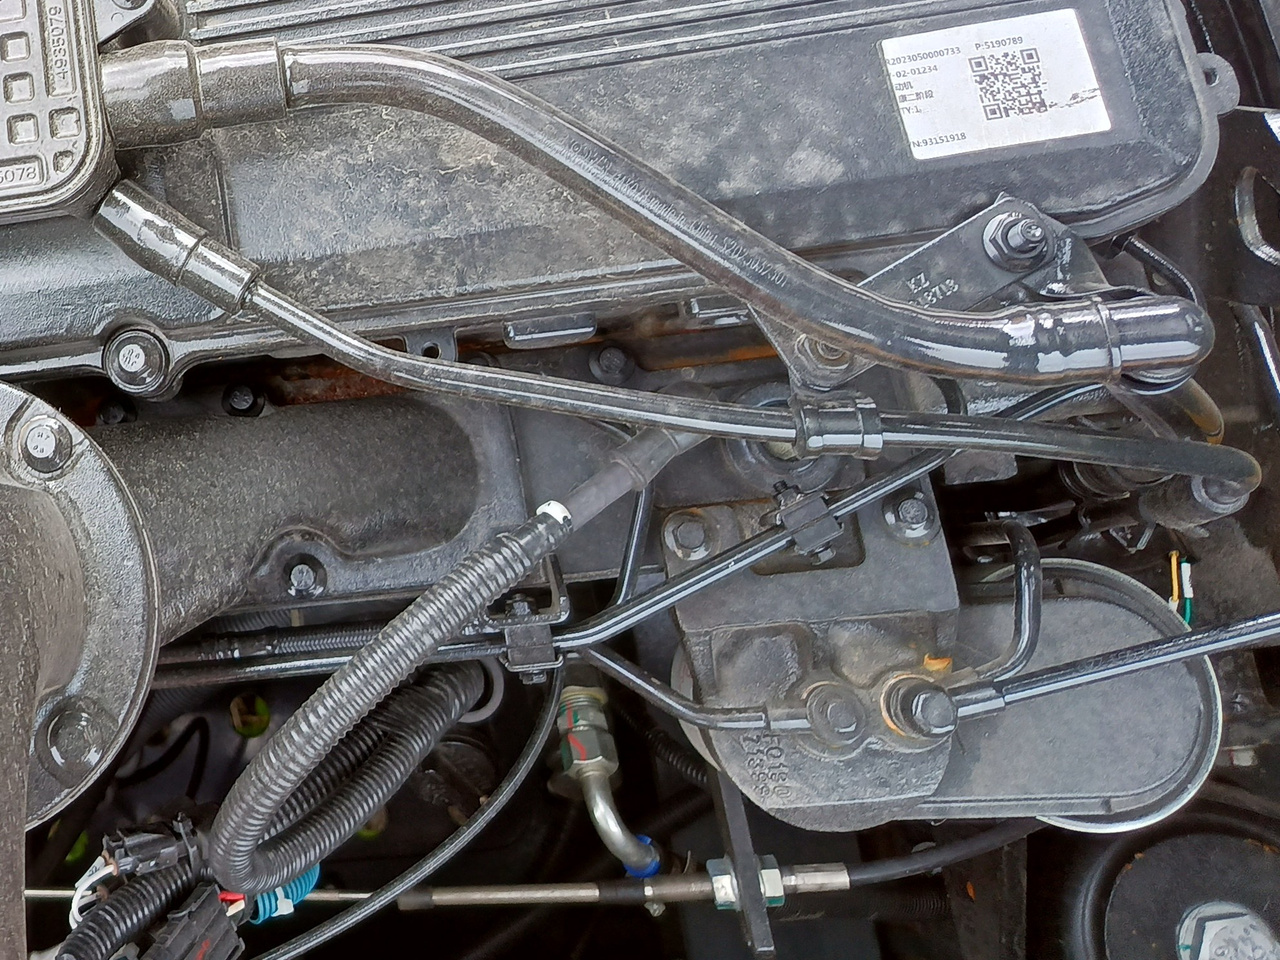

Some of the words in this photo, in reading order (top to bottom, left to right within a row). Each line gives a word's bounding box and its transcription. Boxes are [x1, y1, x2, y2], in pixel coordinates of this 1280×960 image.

[48, 5, 69, 80] 4935079
[974, 36, 1024, 51] P:5190789
[890, 64, 939, 79] -02-01234
